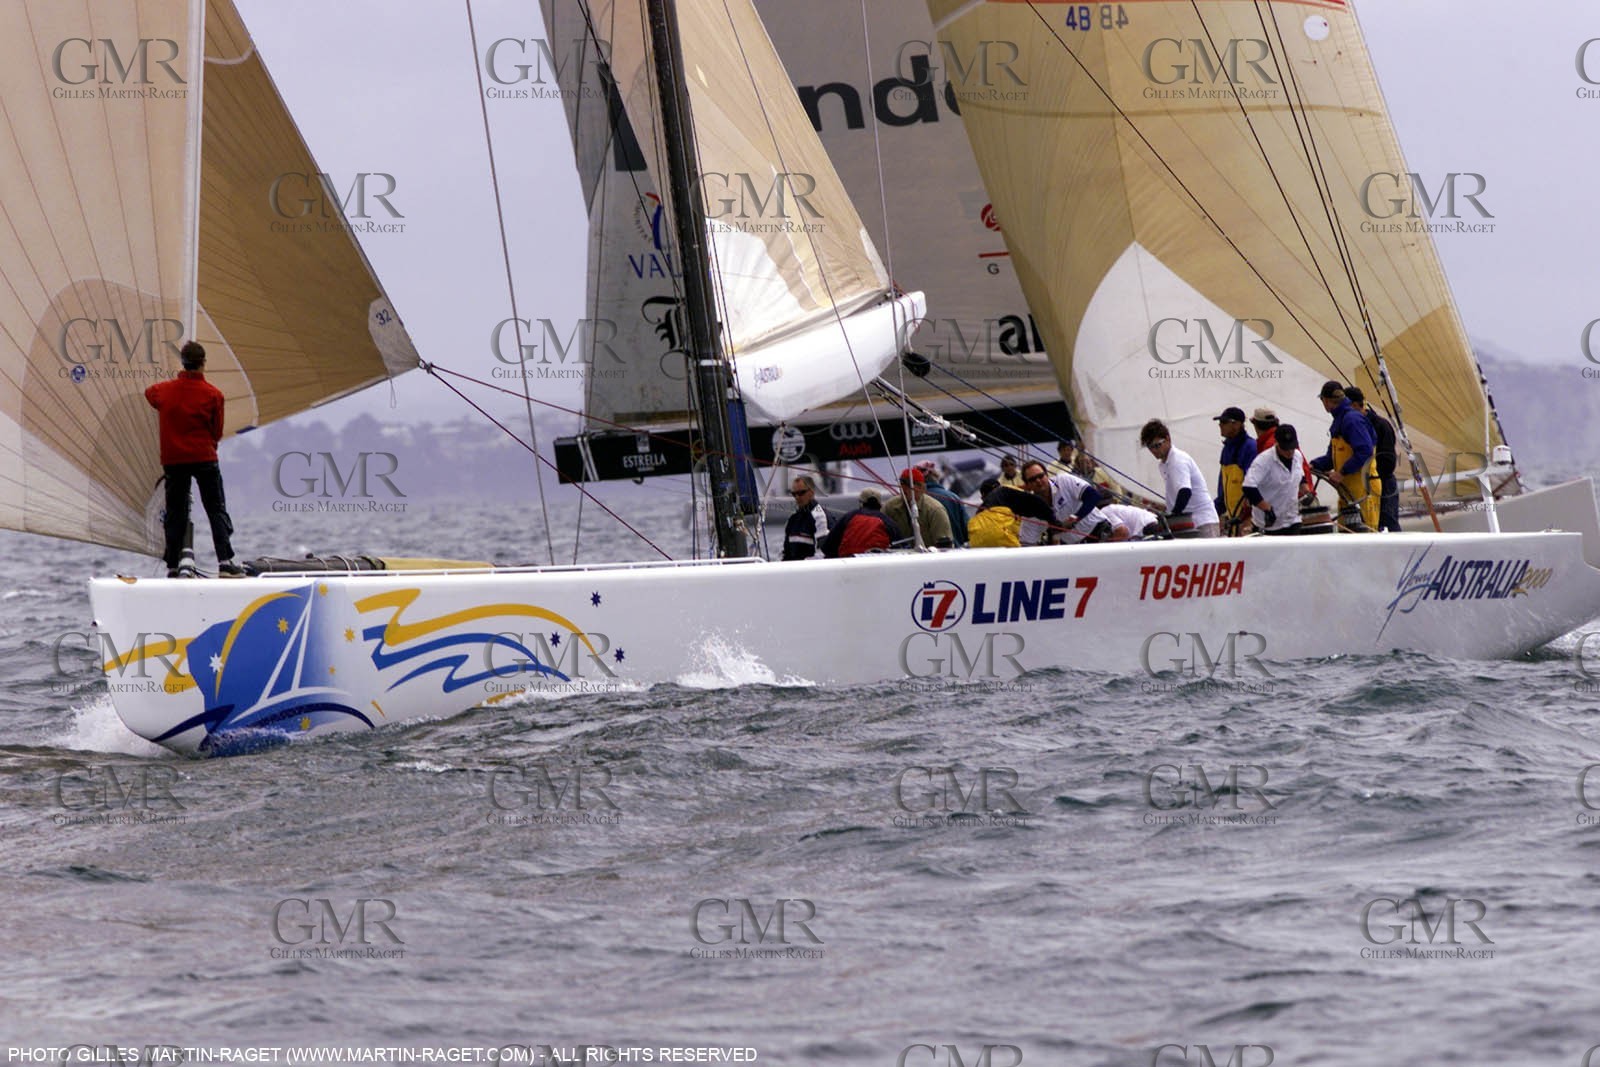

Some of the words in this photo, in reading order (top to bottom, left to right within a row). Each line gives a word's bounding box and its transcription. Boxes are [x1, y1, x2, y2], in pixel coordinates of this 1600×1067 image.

[797, 54, 962, 132] nd
[623, 452, 667, 469] ESTRELLA
[1139, 560, 1245, 600] TOSHIBA
[1423, 555, 1530, 600] AUSTRALIA
[971, 578, 1069, 625] LINE
[1074, 576, 1099, 618] 7
